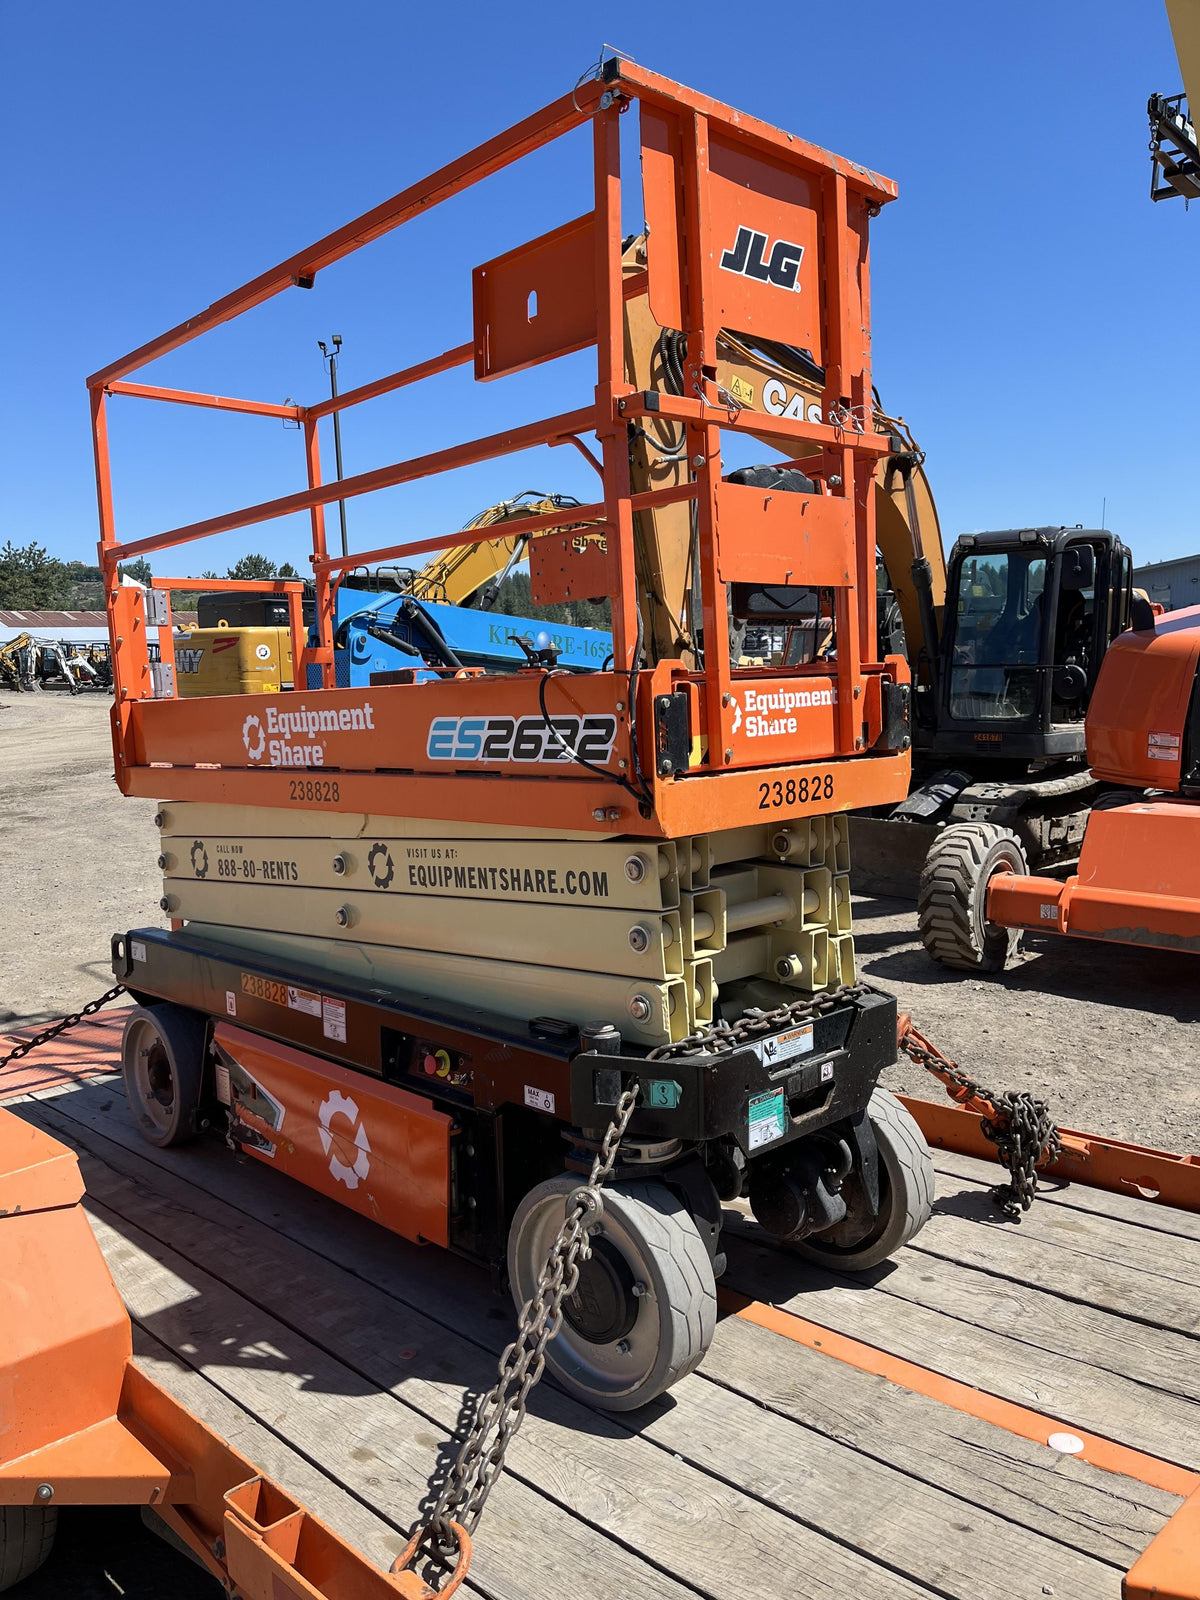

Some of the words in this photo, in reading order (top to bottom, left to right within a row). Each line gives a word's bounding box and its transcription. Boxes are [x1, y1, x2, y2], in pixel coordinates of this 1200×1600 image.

[719, 225, 805, 292] JLG
[762, 378, 822, 424] CAS
[573, 536, 607, 549] Shre
[173, 648, 205, 673] NY
[743, 688, 838, 713] Equipment
[265, 702, 375, 739] Equipment
[745, 717, 798, 738] Share
[427, 714, 617, 764] ES2632
[269, 740, 324, 766] Share
[289, 780, 340, 803] 238828
[758, 774, 834, 810] 238828
[216, 845, 229, 854] CALL
[231, 845, 243, 854] NOW
[406, 848, 427, 859] VISIT
[431, 849, 441, 859] US
[445, 849, 458, 859] AT:
[217, 859, 298, 881] 888-80-RENTS
[408, 865, 609, 897] EQUIPMENTSHARE.COM
[242, 974, 287, 1005] 238828
[527, 1088, 540, 1098] MAX
